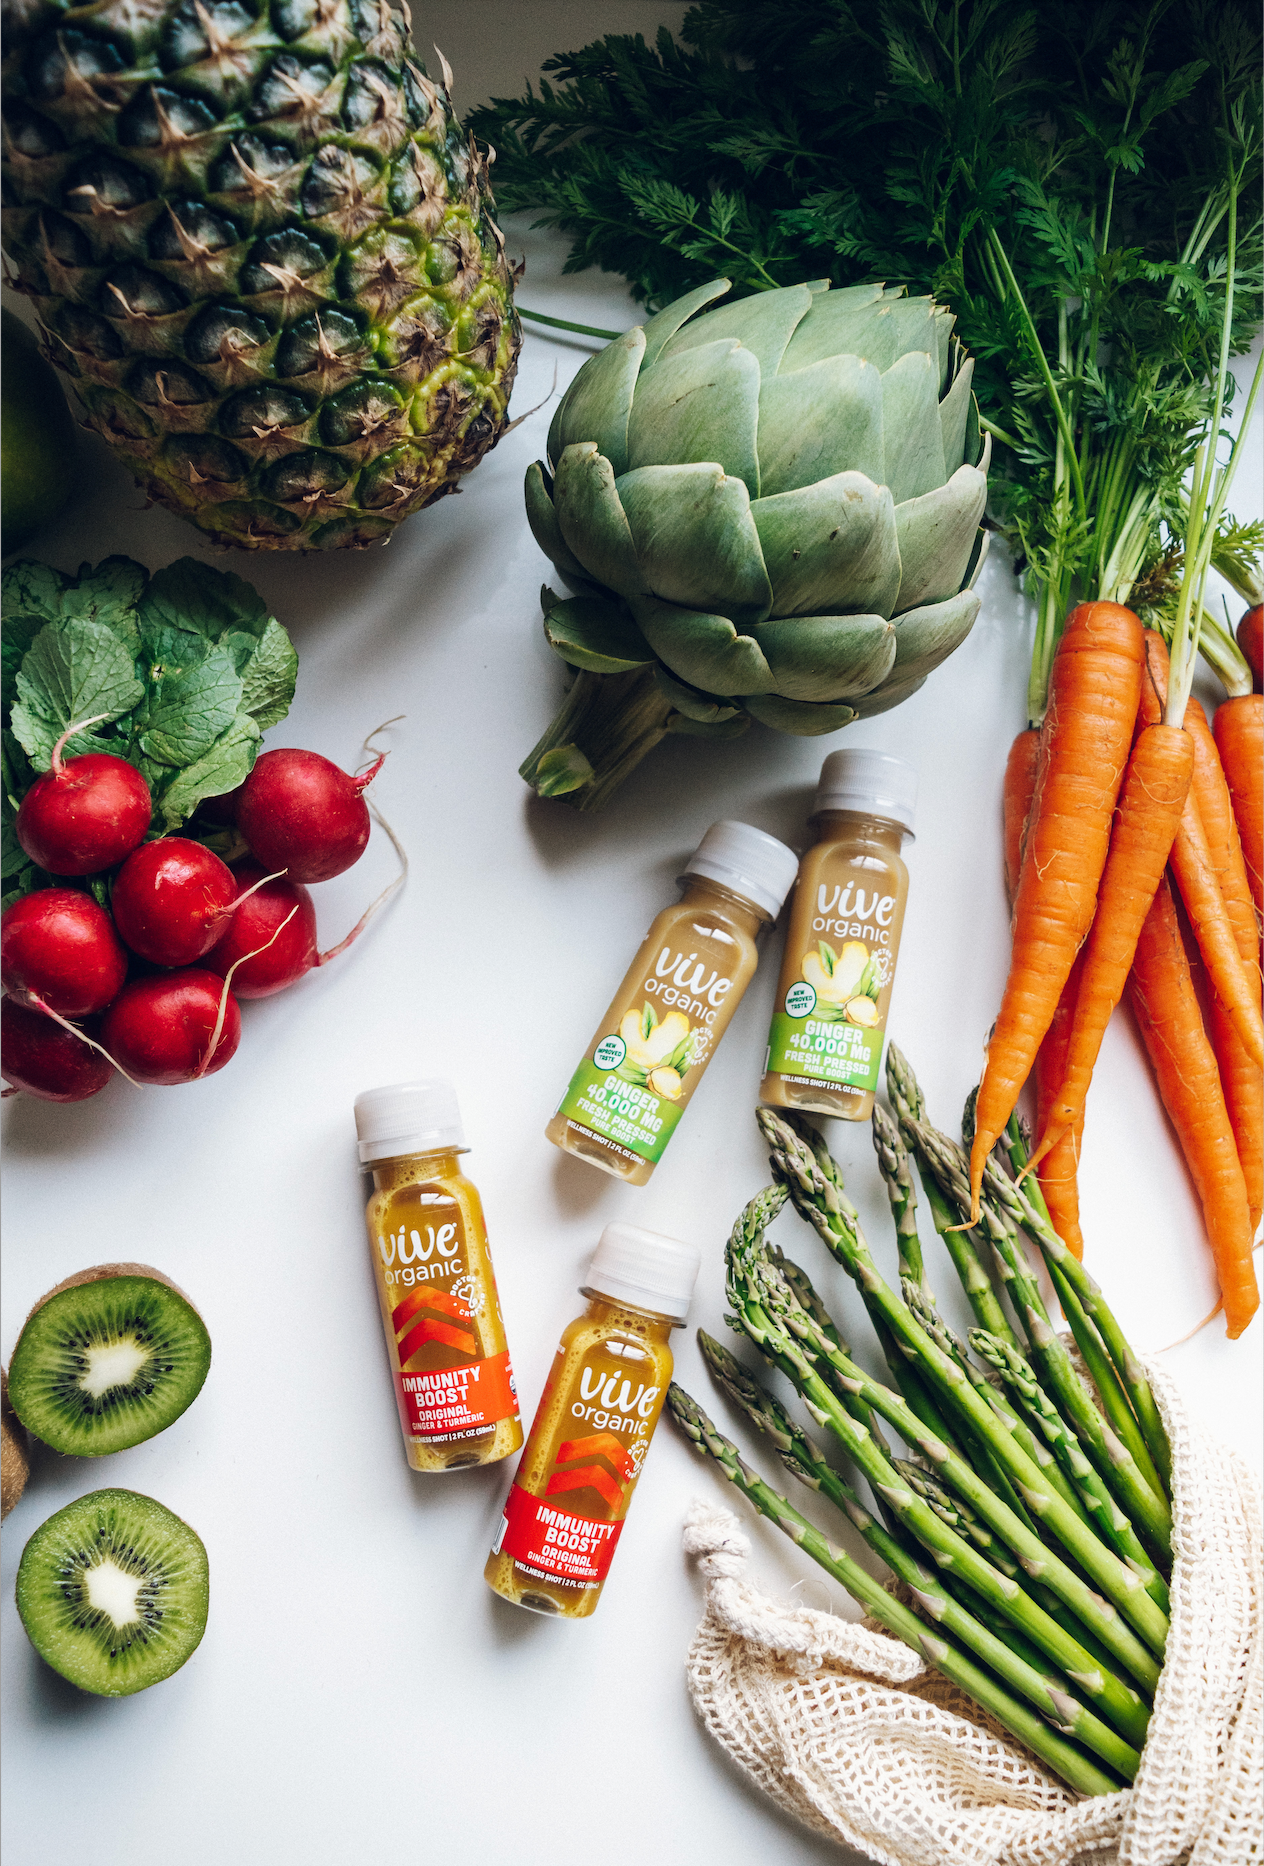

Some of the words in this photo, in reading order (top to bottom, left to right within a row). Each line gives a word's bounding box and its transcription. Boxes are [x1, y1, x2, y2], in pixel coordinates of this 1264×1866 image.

[818, 881, 894, 926] vive
[812, 917, 889, 945] organic
[655, 947, 731, 1007] vive
[644, 978, 718, 1025] organic
[787, 996, 813, 1004] IMPROVED
[791, 1002, 808, 1010] TASTE
[805, 1020, 863, 1044] GINGER
[597, 1048, 622, 1057] IMPROVED
[599, 1054, 615, 1062] TASTE
[790, 1033, 848, 1056] 40,000
[850, 1043, 871, 1062] MG
[784, 1050, 821, 1066] FRESH
[823, 1056, 870, 1076] PRESSED
[803, 1063, 825, 1075] PURE
[826, 1067, 851, 1080] BOOST
[604, 1075, 660, 1114] GINGER
[780, 1074, 810, 1085] WELLNESS
[809, 1078, 827, 1088] SHOT
[835, 1084, 843, 1092] FL
[842, 1085, 851, 1094] OZ
[576, 1097, 611, 1121] FRESH
[611, 1115, 657, 1146] PRESSED
[587, 1084, 640, 1120] 40,000
[640, 1111, 663, 1133] MG
[566, 1119, 593, 1138] WELLNESS
[591, 1132, 609, 1146] SHOT
[615, 1145, 622, 1153] FL
[622, 1149, 631, 1158] OZ
[590, 1116, 611, 1132] PURE
[611, 1127, 636, 1145] BOOST
[378, 1222, 458, 1267] vive
[384, 1259, 463, 1286] organic
[450, 1275, 477, 1296] DOCTOR
[459, 1293, 485, 1317] CRAFTED
[402, 1366, 480, 1392] IMMUNITY
[580, 1366, 658, 1417] vive
[415, 1385, 469, 1407] BOOST
[412, 1421, 435, 1431] GINGER
[436, 1421, 443, 1429] &
[443, 1412, 484, 1428] TURMERIC
[419, 1404, 471, 1421] ORIGINAL
[571, 1402, 648, 1435] organic
[431, 1434, 448, 1442] SHOT
[457, 1431, 465, 1439] FL
[465, 1427, 476, 1436] OZ
[536, 1505, 615, 1540] IMMUNITY
[545, 1526, 600, 1553] BOOST
[527, 1551, 555, 1568] GINGER
[556, 1561, 562, 1570] &
[564, 1563, 598, 1577] TURMERIC
[541, 1545, 592, 1567] ORIGINAL
[514, 1560, 545, 1579] WELLNESS
[545, 1573, 562, 1585] SHOT
[569, 1579, 577, 1588] FL
[577, 1581, 586, 1589] OZ
